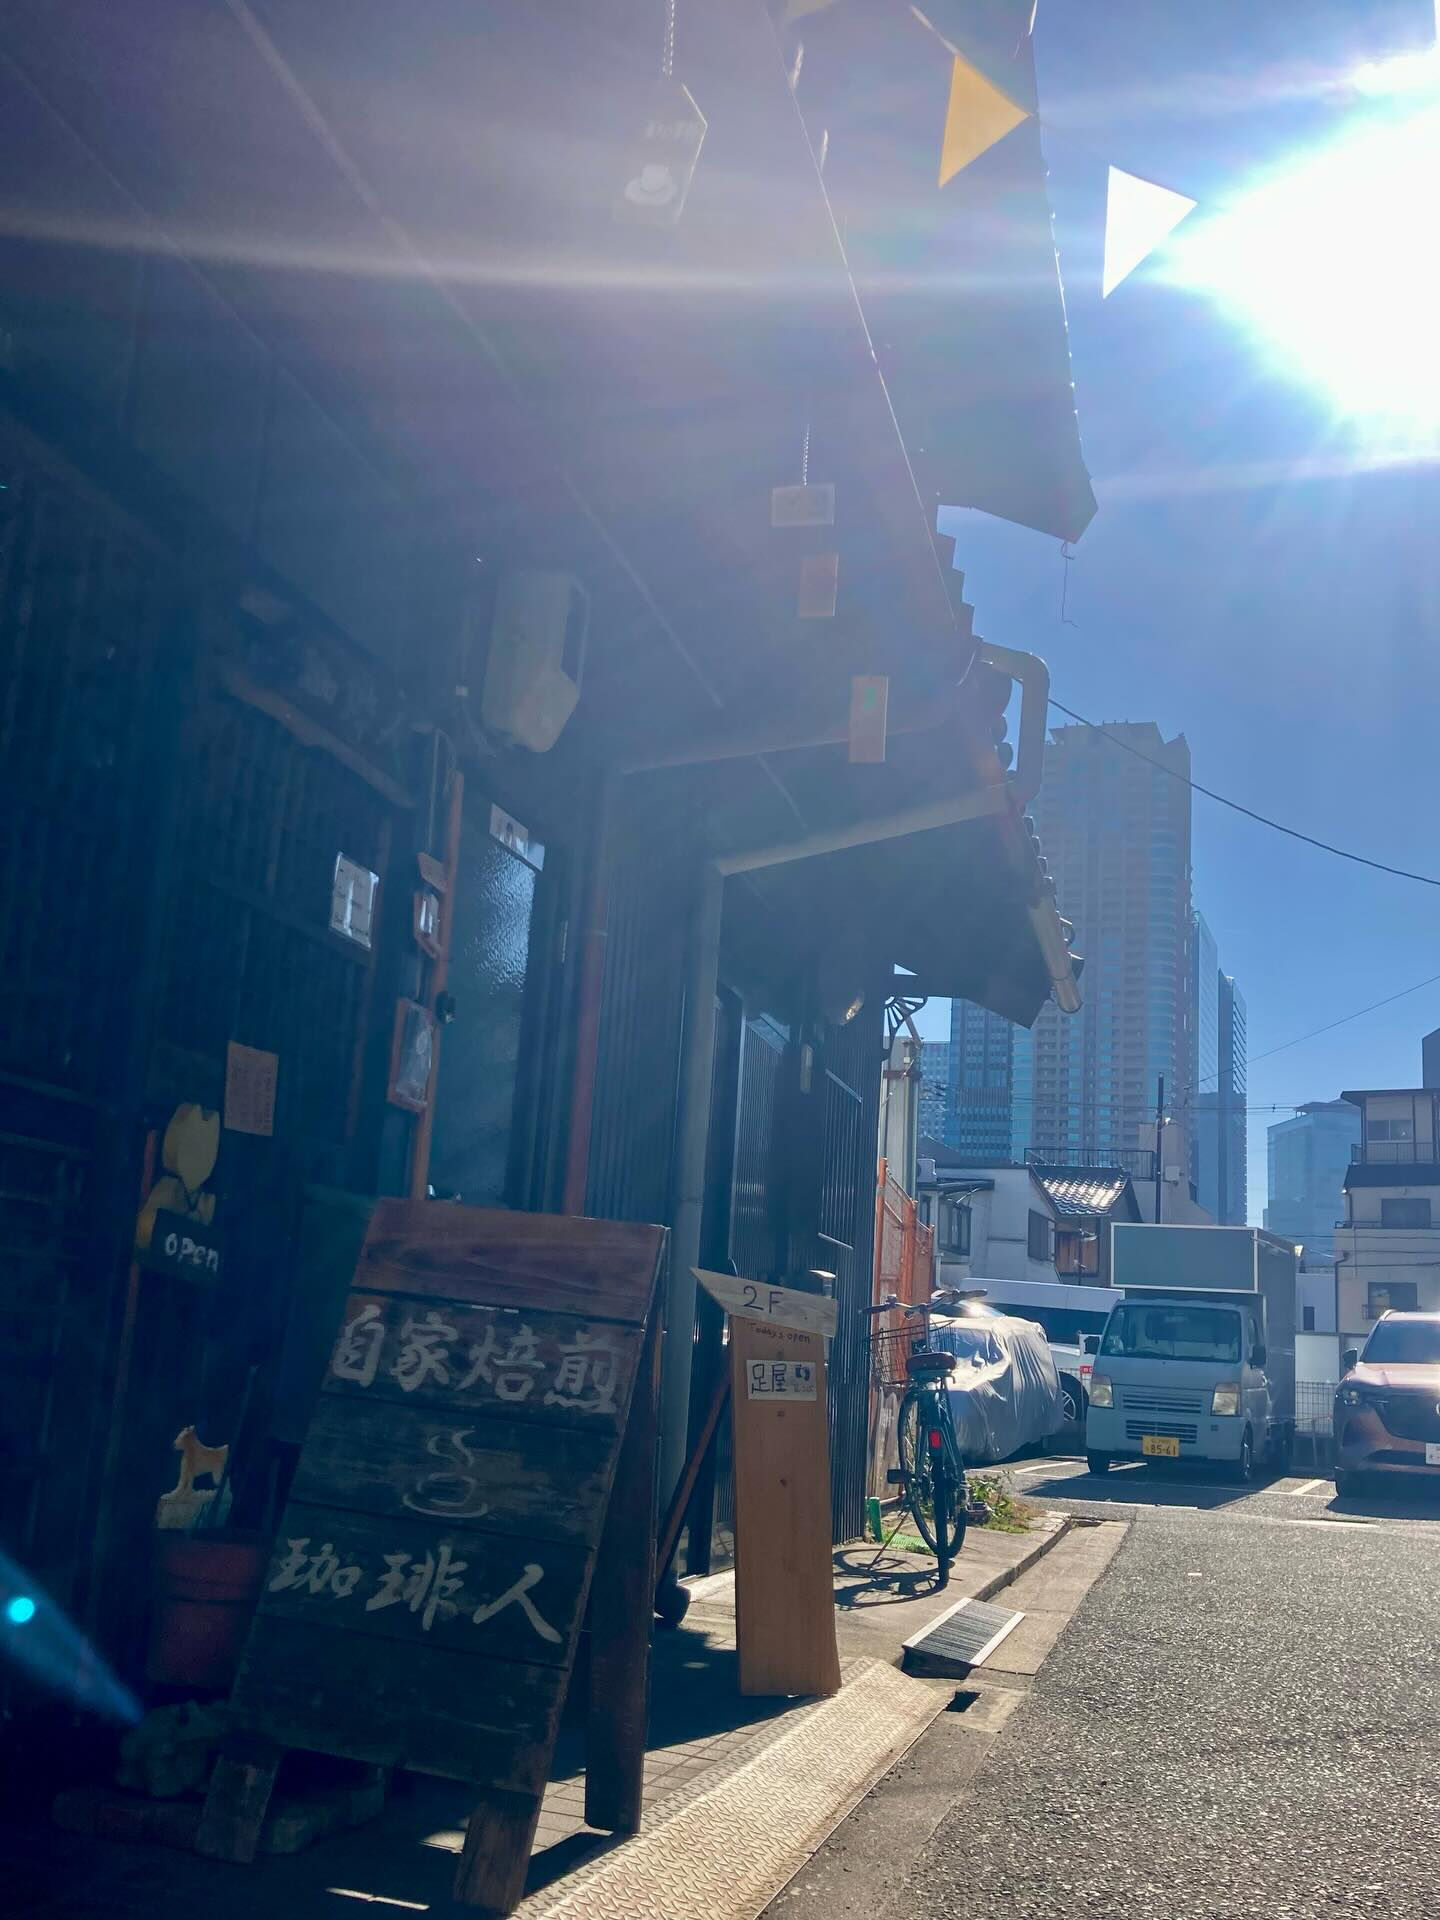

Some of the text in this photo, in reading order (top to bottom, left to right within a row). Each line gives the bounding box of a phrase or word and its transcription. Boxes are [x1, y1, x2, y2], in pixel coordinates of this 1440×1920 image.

[743, 1286, 783, 1314] 2F
[331, 1303, 618, 1413] 自家焙煎
[268, 1537, 564, 1643] 珈琲人
